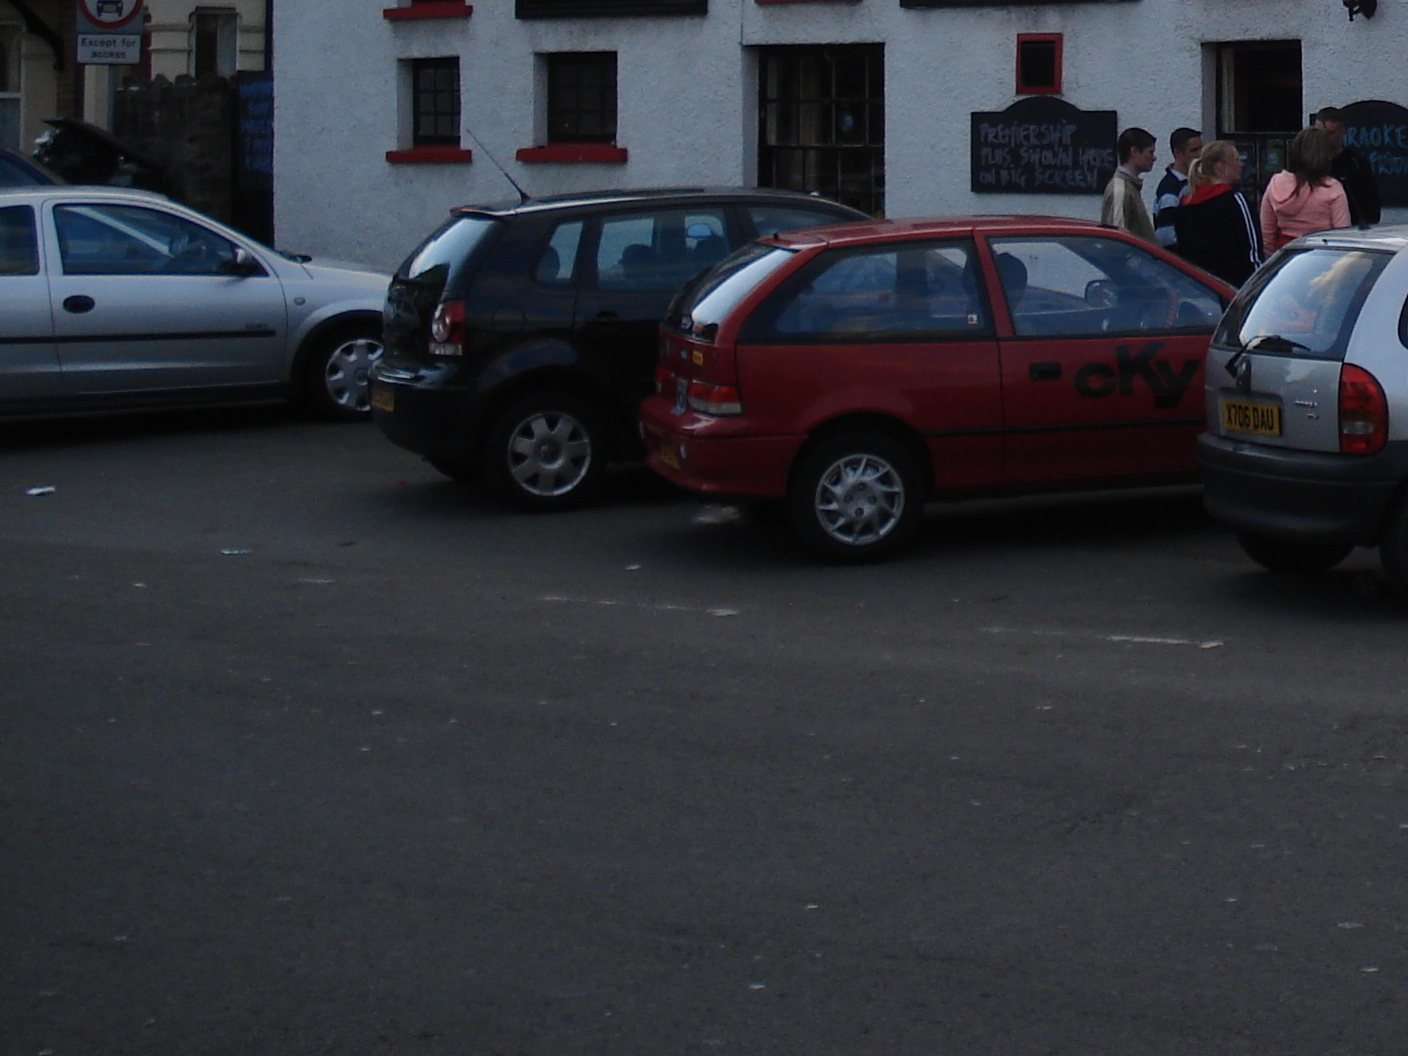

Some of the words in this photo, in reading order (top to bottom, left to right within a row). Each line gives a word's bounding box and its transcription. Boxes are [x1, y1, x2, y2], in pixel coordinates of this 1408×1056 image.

[81, 37, 117, 48] Except
[121, 38, 137, 48] for
[1226, 403, 1250, 429] X706
[1252, 407, 1275, 431] DAU
